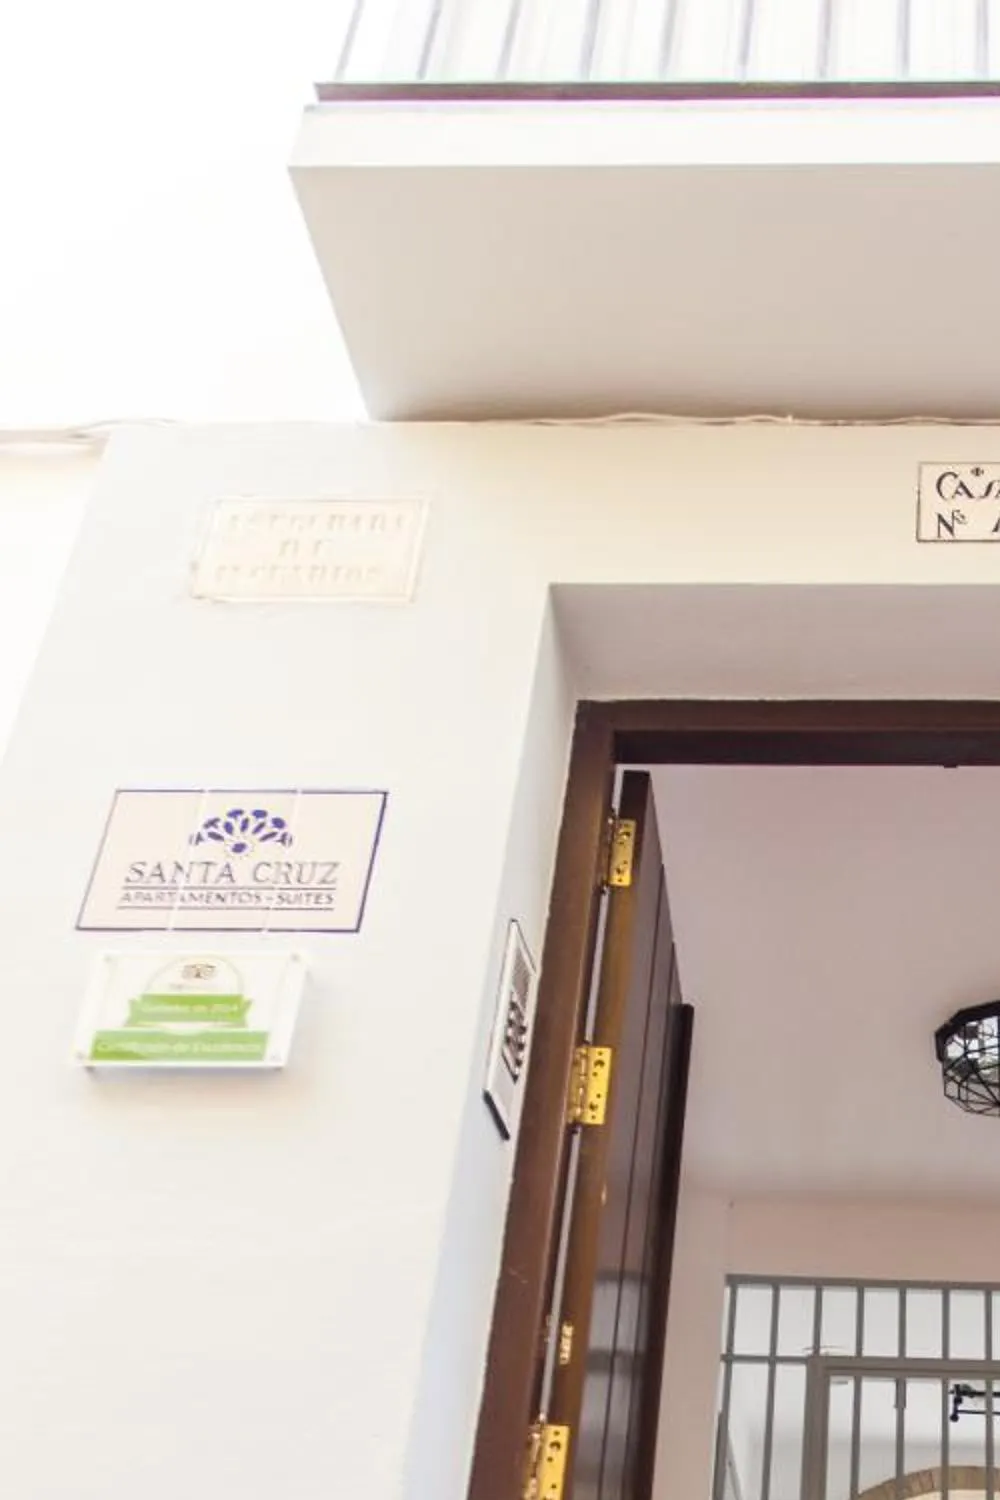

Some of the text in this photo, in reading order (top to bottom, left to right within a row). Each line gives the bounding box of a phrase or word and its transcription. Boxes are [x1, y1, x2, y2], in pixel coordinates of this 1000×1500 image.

[124, 861, 340, 885] SANTA CRUZ
[277, 891, 334, 905] SUITES
